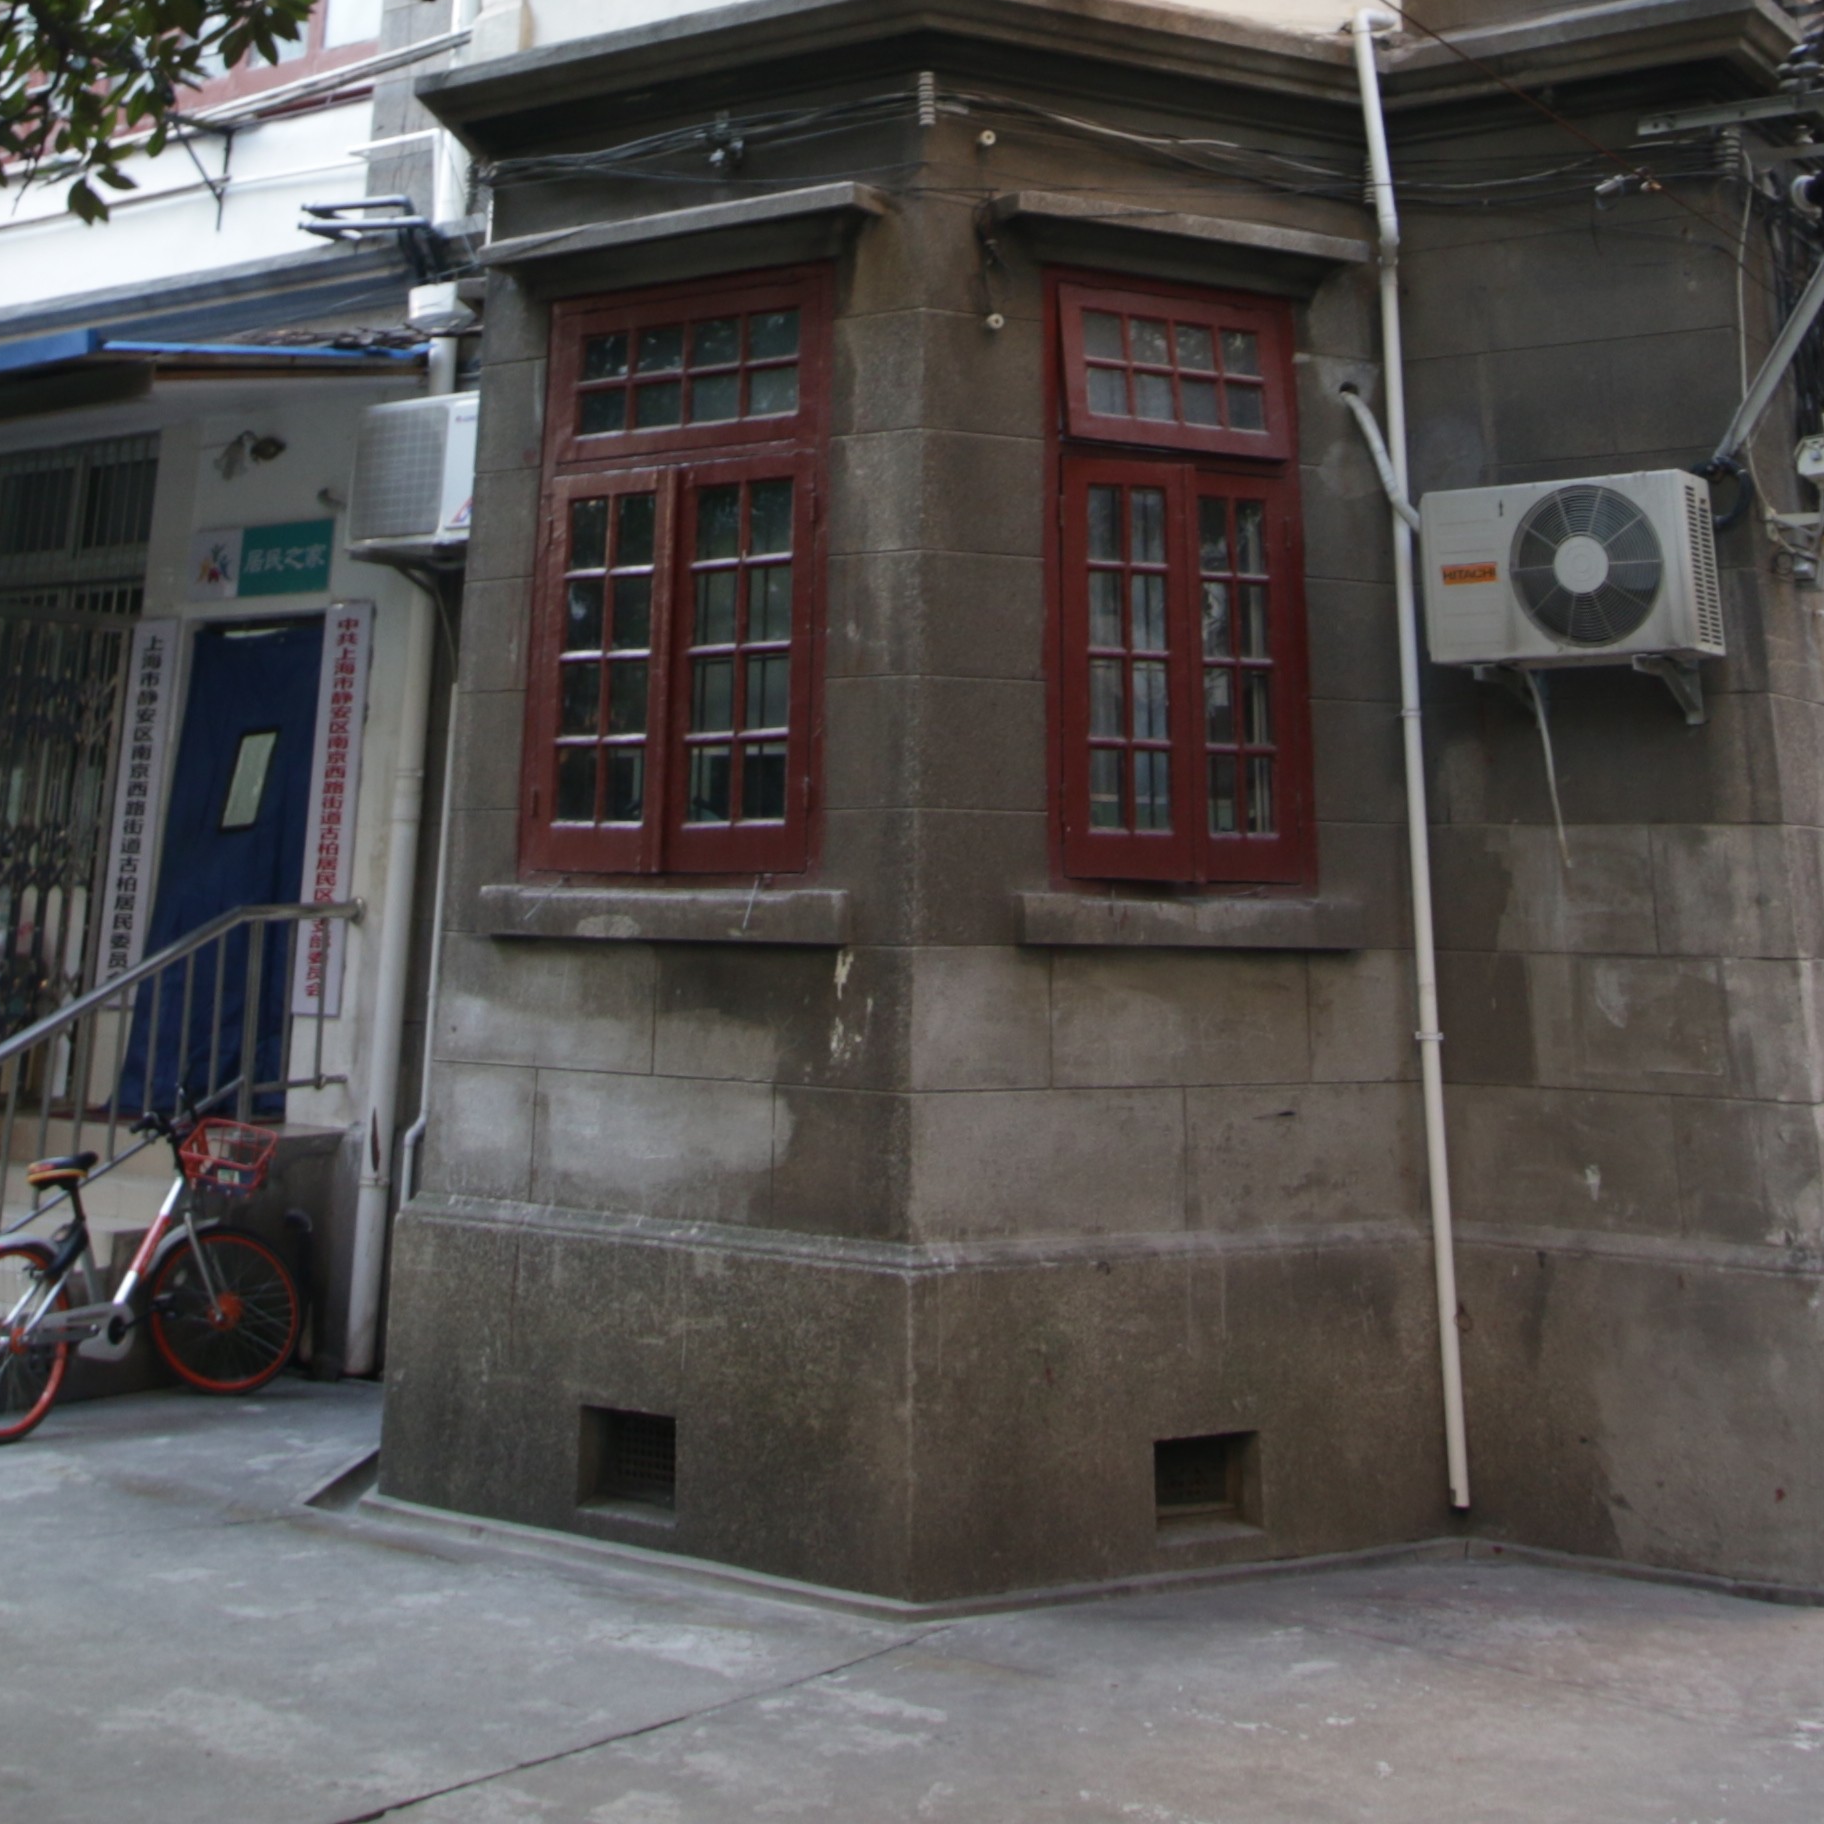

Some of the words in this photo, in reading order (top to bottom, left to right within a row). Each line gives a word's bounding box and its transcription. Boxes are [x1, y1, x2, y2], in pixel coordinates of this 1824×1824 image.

[245, 543, 326, 573] 居民之家
[1443, 567, 1496, 581] HITACHI
[305, 617, 359, 997] 中共上海市静安区南京西路街道古柏居民区支部委员会
